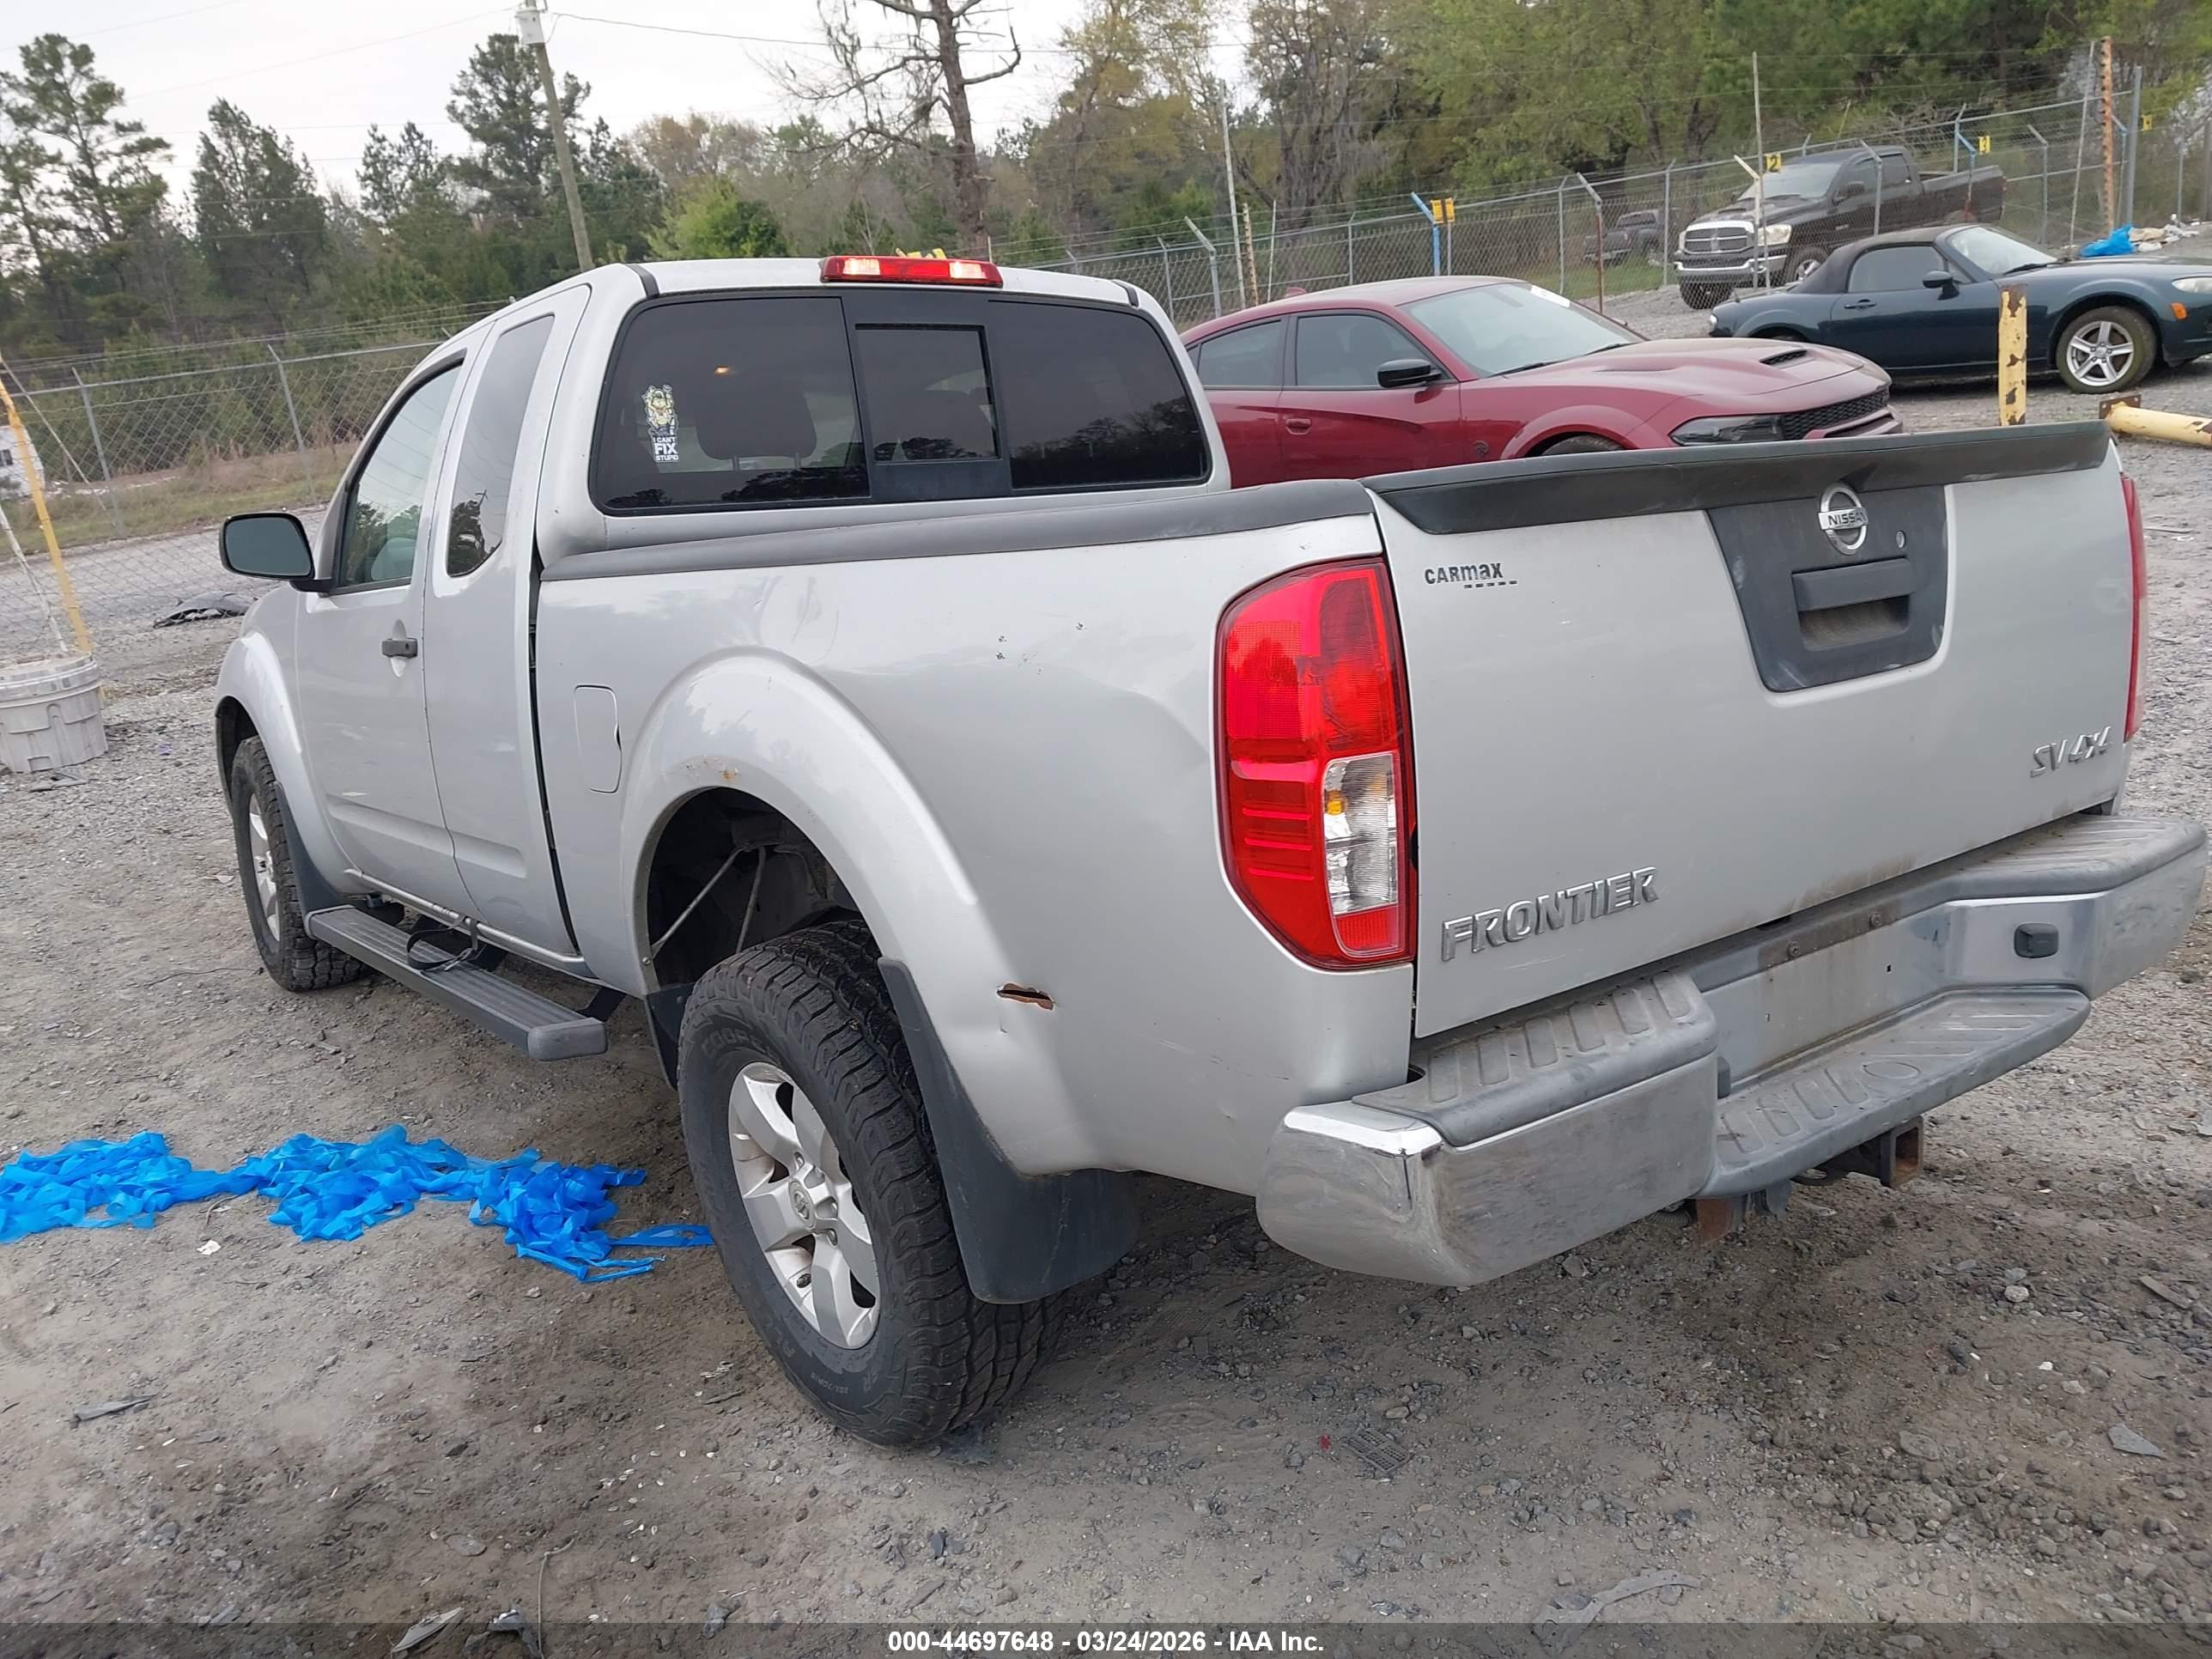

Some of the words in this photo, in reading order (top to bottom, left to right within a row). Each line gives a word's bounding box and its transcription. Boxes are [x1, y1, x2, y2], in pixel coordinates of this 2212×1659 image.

[1769, 155, 1779, 173] 2
[654, 443, 678, 455] FIX
[1827, 512, 1867, 526] NISSAN
[1441, 866, 1659, 962] FRONTIER
